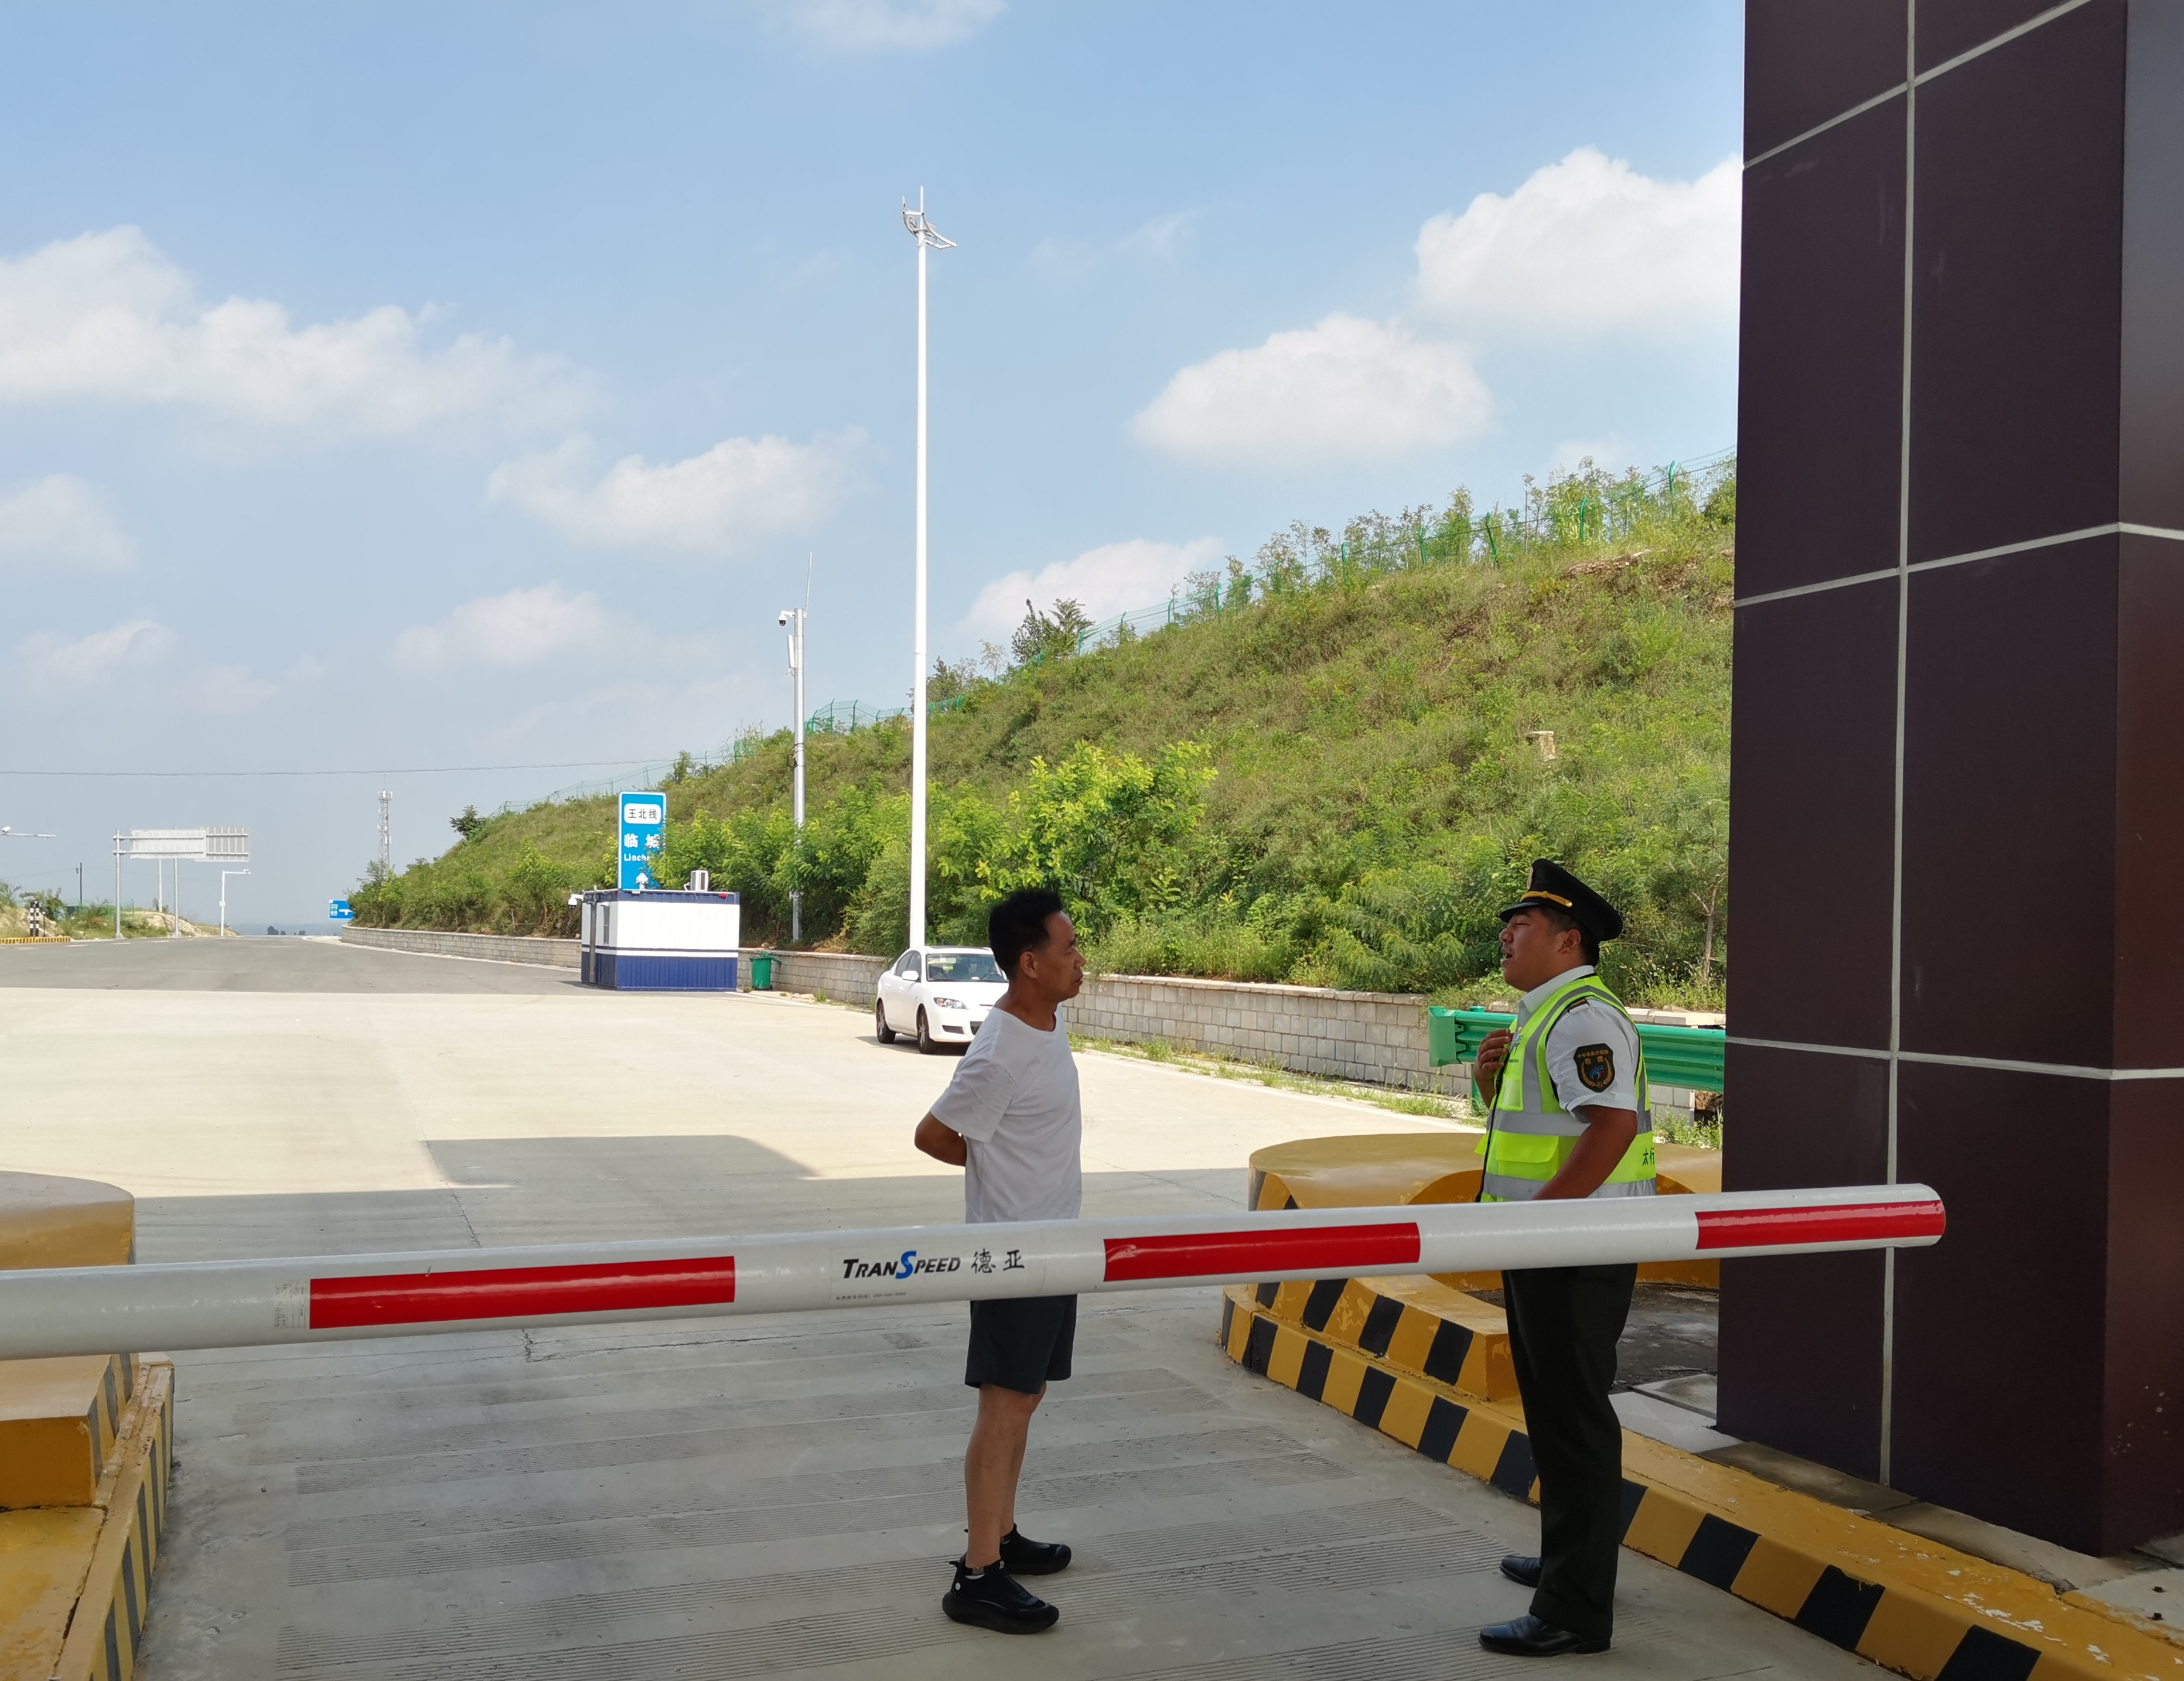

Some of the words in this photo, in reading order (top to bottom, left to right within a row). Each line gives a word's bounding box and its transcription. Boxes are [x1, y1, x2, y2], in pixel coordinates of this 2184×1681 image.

[628, 808, 657, 819] 王北线
[624, 853, 652, 862] Linche
[970, 1248, 1025, 1274] 德亚
